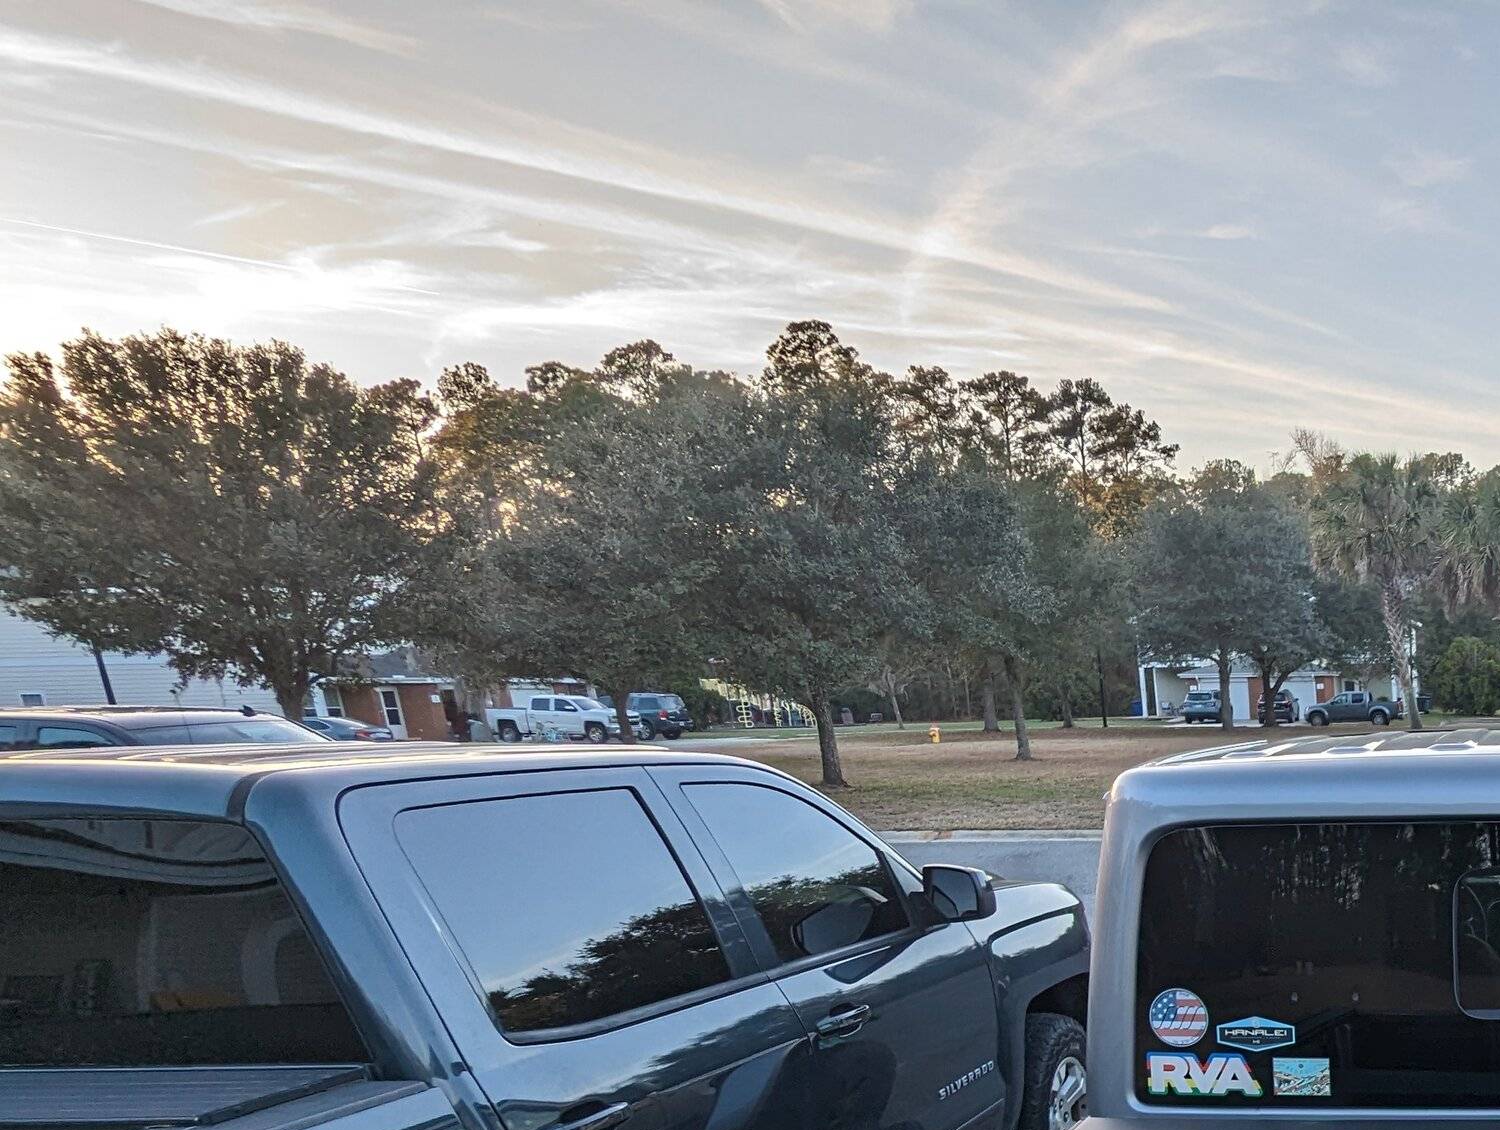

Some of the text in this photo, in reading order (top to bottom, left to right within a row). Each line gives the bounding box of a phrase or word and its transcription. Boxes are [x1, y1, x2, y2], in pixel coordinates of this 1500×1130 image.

[1224, 1028, 1288, 1038] HANALEI
[938, 1060, 994, 1100] SILVERADO
[1148, 1053, 1262, 1096] RVA
